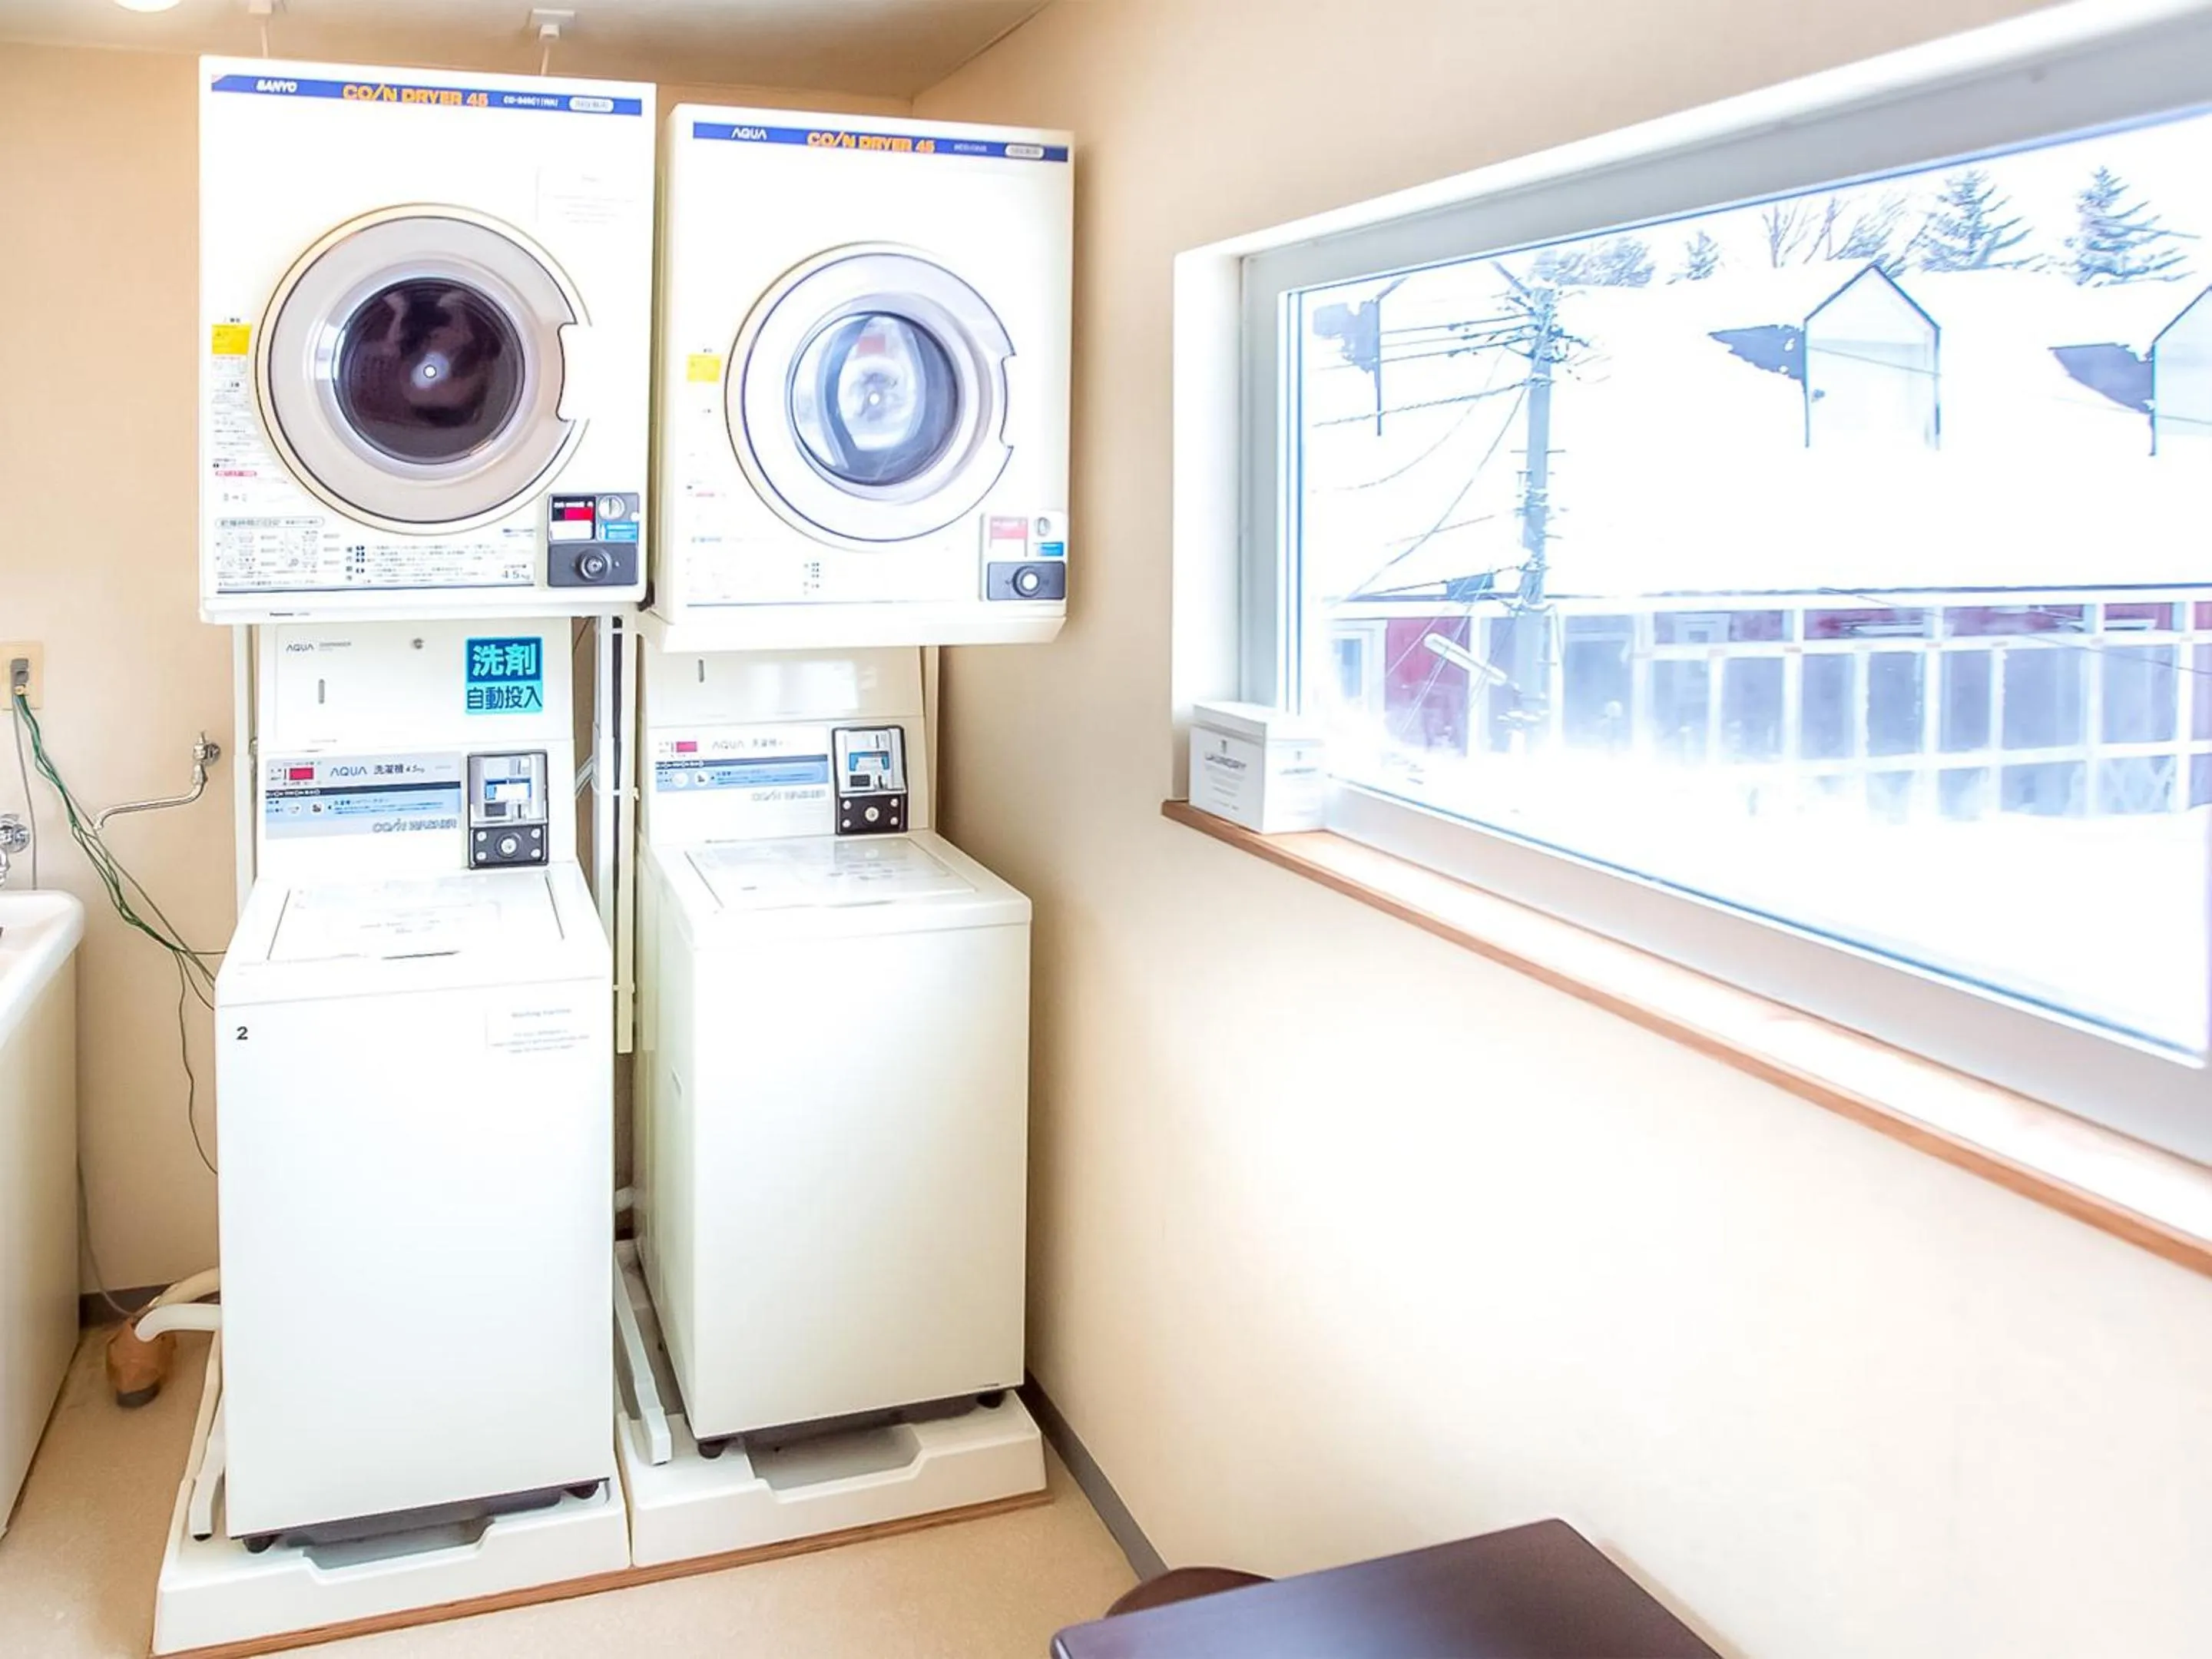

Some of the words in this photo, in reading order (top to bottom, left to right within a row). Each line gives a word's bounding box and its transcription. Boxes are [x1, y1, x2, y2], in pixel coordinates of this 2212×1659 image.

[256, 79, 298, 93] SANYO
[402, 88, 462, 106] DRYER
[467, 92, 488, 108] 45
[731, 127, 767, 141] AQUA
[859, 136, 912, 151] DRYER
[286, 643, 314, 652] AQUA
[472, 643, 537, 677] 洗剤
[466, 685, 542, 710] 自動投入
[330, 766, 367, 777] AQUA
[236, 1025, 249, 1041] 2
